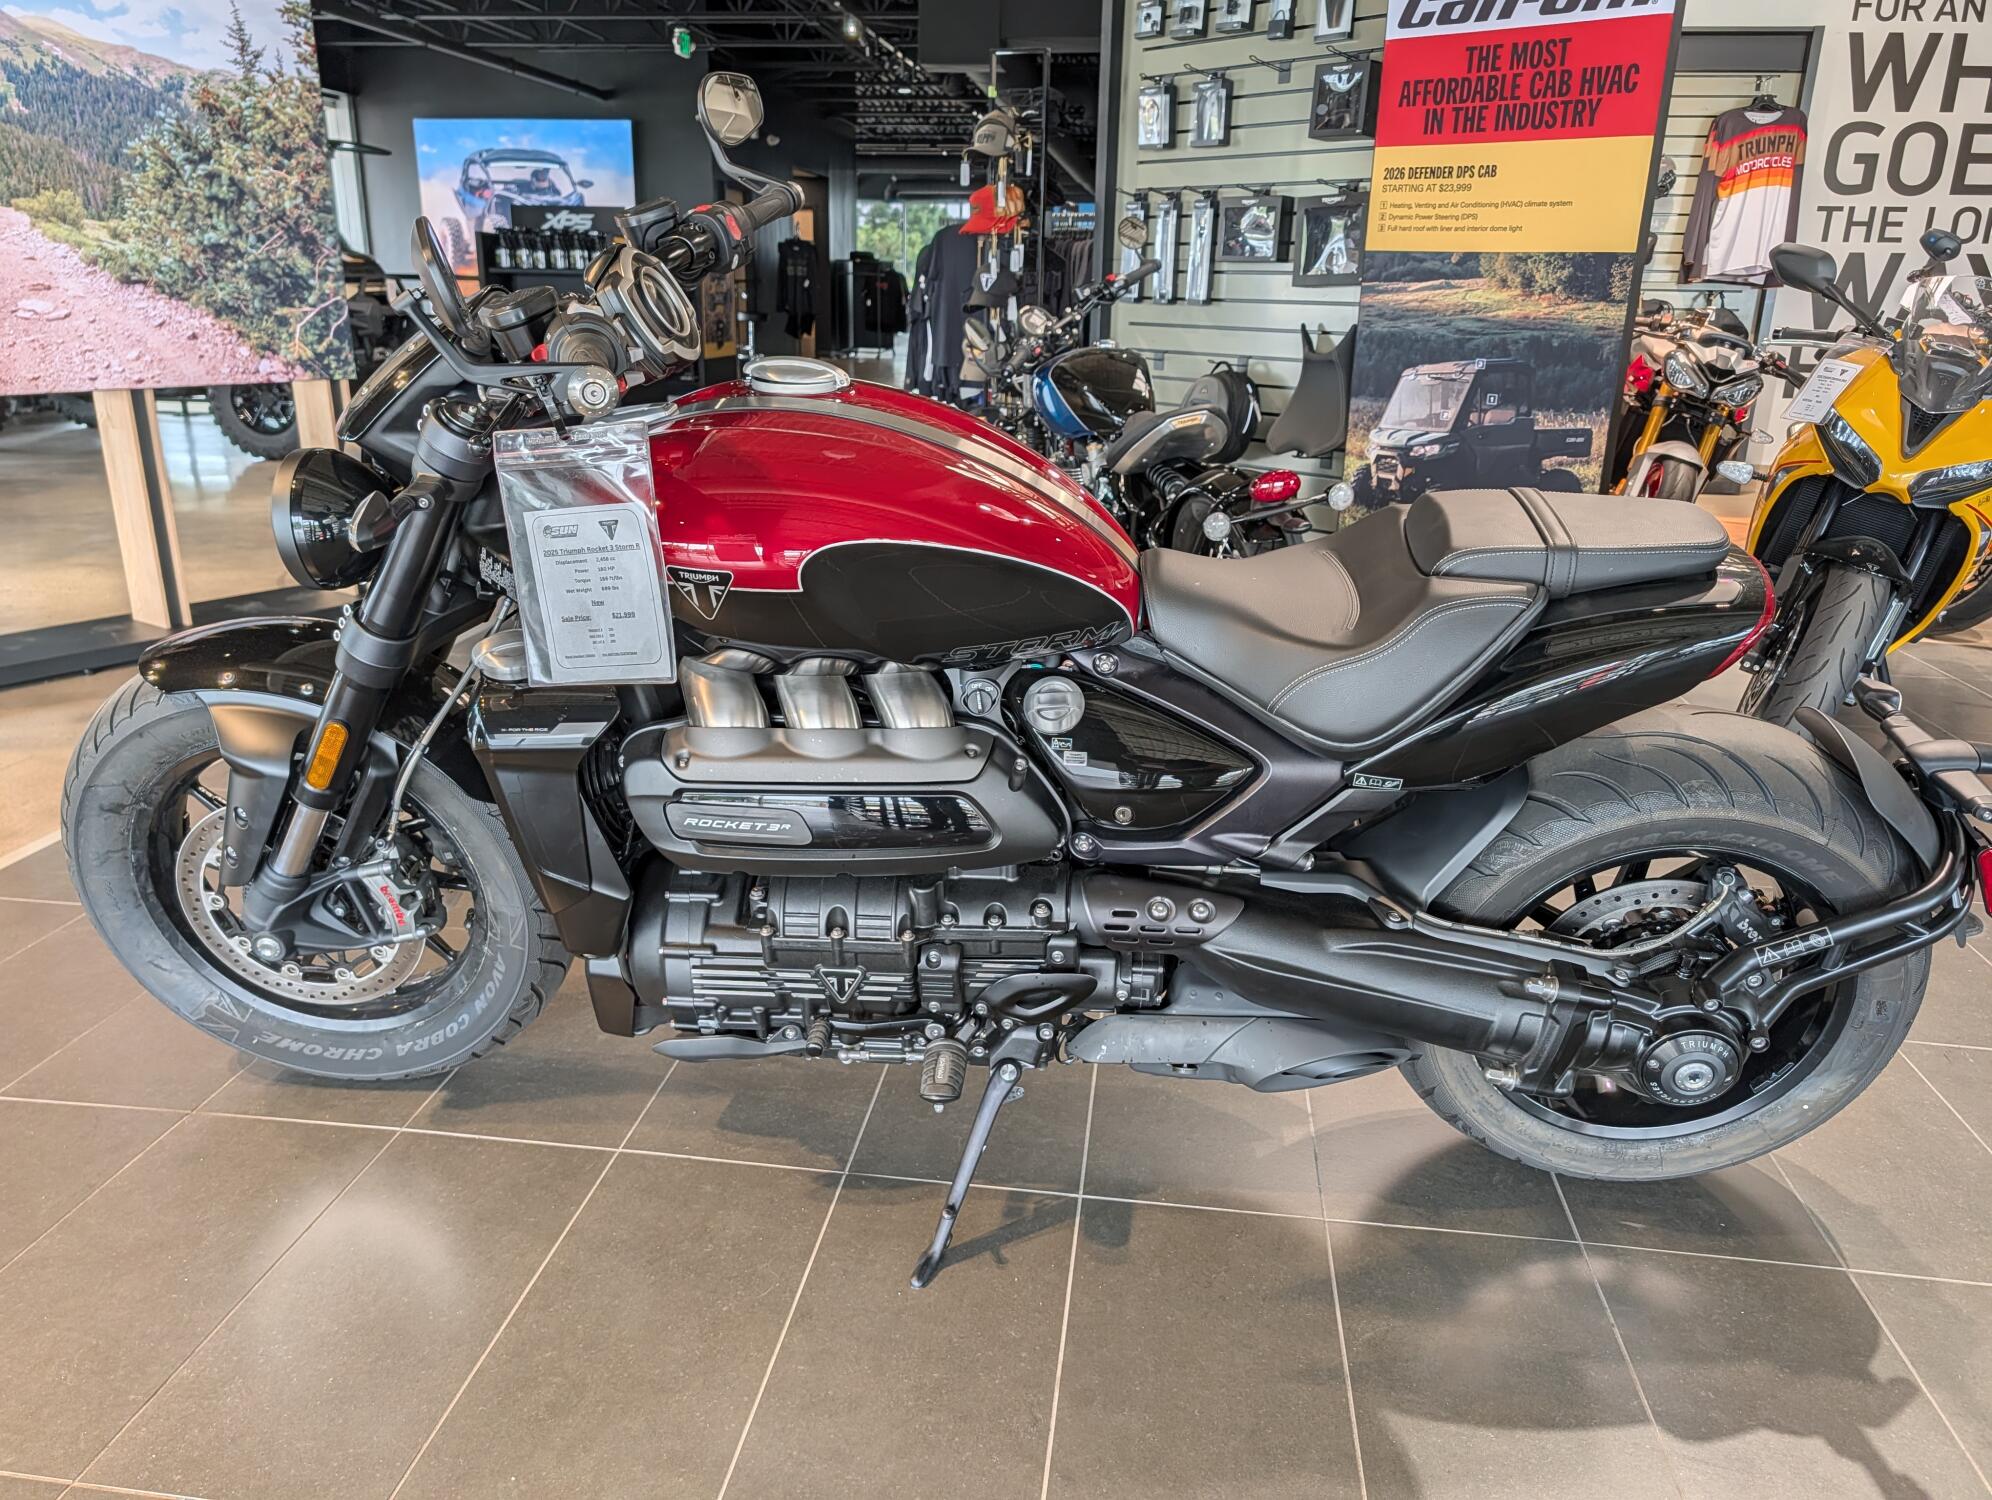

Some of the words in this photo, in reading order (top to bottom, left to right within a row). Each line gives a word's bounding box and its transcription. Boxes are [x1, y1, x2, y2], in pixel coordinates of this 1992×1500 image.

[1852, 0, 1927, 22] FOR
[1466, 44, 1504, 74] THE
[1509, 38, 1572, 70] MOST
[1849, 32, 1992, 113] WH
[1398, 73, 1523, 107] AFFORDABLE
[1530, 70, 1572, 97] CAB
[1579, 63, 1640, 96] HVAC
[1423, 108, 1444, 135] IN
[1452, 105, 1489, 133] THE
[1494, 98, 1603, 131] INDUSTRY
[1384, 167, 1406, 180] 2026
[1408, 166, 1454, 179] DEFENDER
[1456, 165, 1475, 178] DPS
[1478, 164, 1498, 178] CAB
[1735, 156, 1793, 176] MOTORCCLES
[1382, 184, 1424, 193] STARTING
[1425, 183, 1437, 192] AT
[1438, 183, 1472, 193] $23,999
[1389, 202, 1413, 210] Heating,
[1415, 202, 1437, 210] Venting
[1460, 201, 1500, 210] Conditioning
[1500, 200, 1523, 208] (HVAC)
[1549, 200, 1573, 208] system
[540, 210, 595, 231] XPS
[1388, 213, 1413, 221] Dynamic
[1434, 213, 1460, 221] Steering
[1817, 206, 1908, 243] THE
[1508, 225, 1523, 233] light
[551, 525, 577, 536] SUN
[560, 546, 586, 556] Triumph
[586, 545, 609, 553] Rocket
[615, 543, 635, 551] Storm
[678, 571, 720, 582] TRIUMPH
[942, 620, 1122, 662] STORM
[396, 1009, 471, 1057] COBRA
[259, 1030, 383, 1061] CHROME
[1680, 1040, 1729, 1058] TRIUMPH
